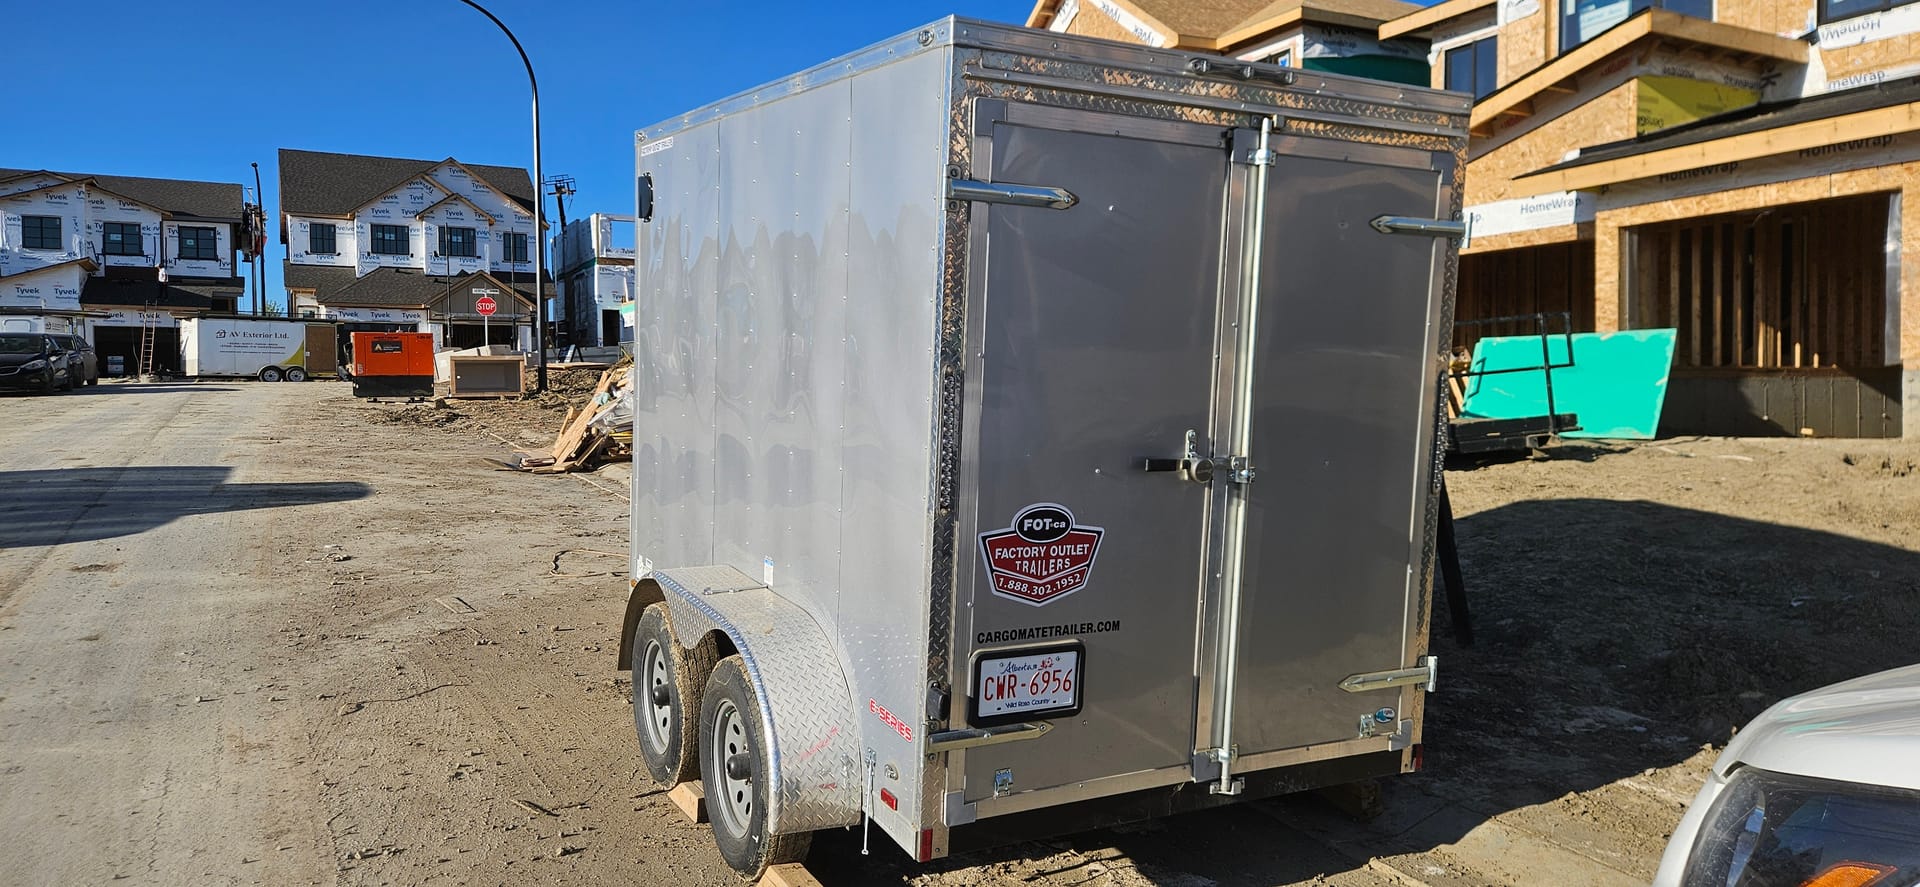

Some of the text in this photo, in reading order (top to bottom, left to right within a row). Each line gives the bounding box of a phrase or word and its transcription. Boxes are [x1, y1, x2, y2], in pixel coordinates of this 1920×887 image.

[1520, 197, 1581, 215] HomeWrap
[16, 287, 40, 295] Tyvek
[55, 288, 78, 296] Tyvek
[371, 311, 391, 319] Tyvek
[995, 544, 1089, 559] FACTORY OUTLET
[1016, 558, 1070, 576] TRAILERS
[998, 573, 1081, 595] 1.888.302.1952
[977, 621, 1120, 643] CARGOMATETRAILER.COM
[1001, 662, 1034, 674] Alberta
[984, 669, 1073, 701] CWR-6956
[869, 699, 912, 741] E-SERIES
